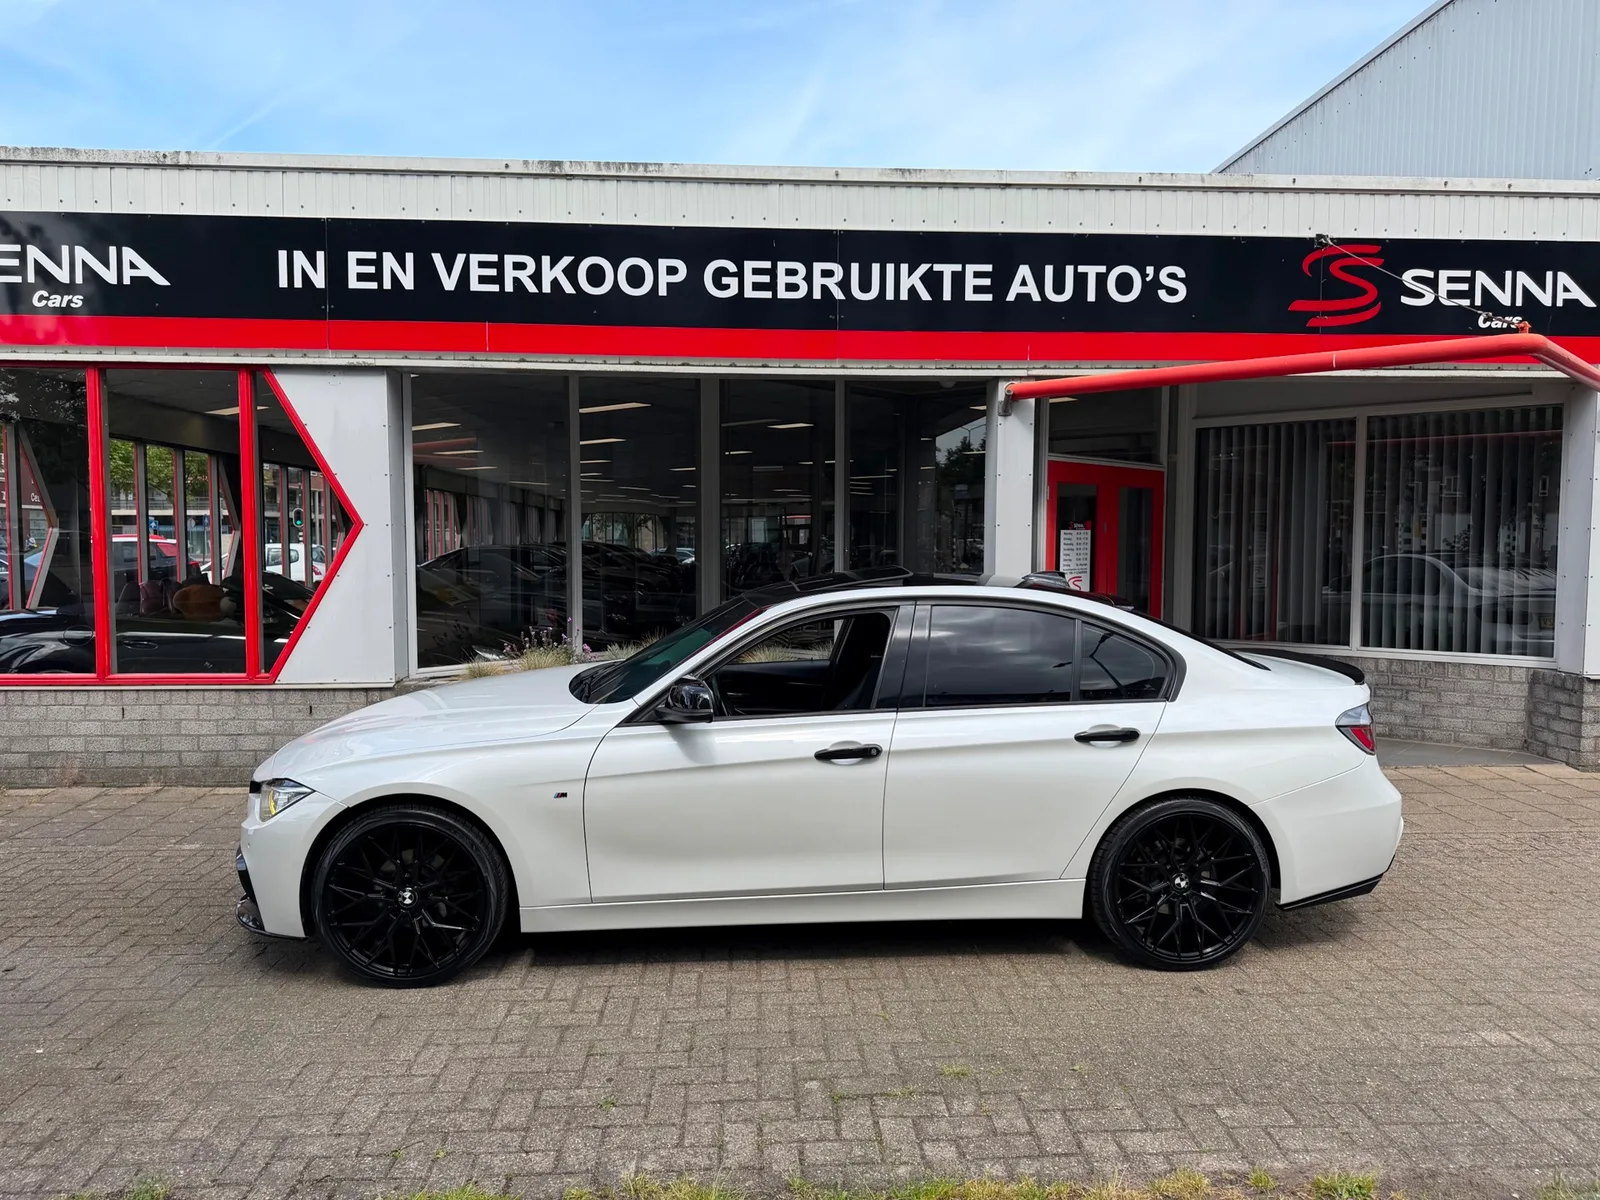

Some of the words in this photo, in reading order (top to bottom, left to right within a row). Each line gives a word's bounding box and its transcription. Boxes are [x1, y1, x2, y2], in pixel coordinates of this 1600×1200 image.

[277, 249, 326, 289] IN
[347, 250, 415, 291] EN
[430, 252, 688, 298] VERKOOP
[703, 258, 993, 302] GEBRUIKTE
[1005, 264, 1187, 304] AUTO'S
[1400, 268, 1598, 308] SENNA
[31, 289, 84, 309] Cars
[1477, 311, 1523, 329] Cars
